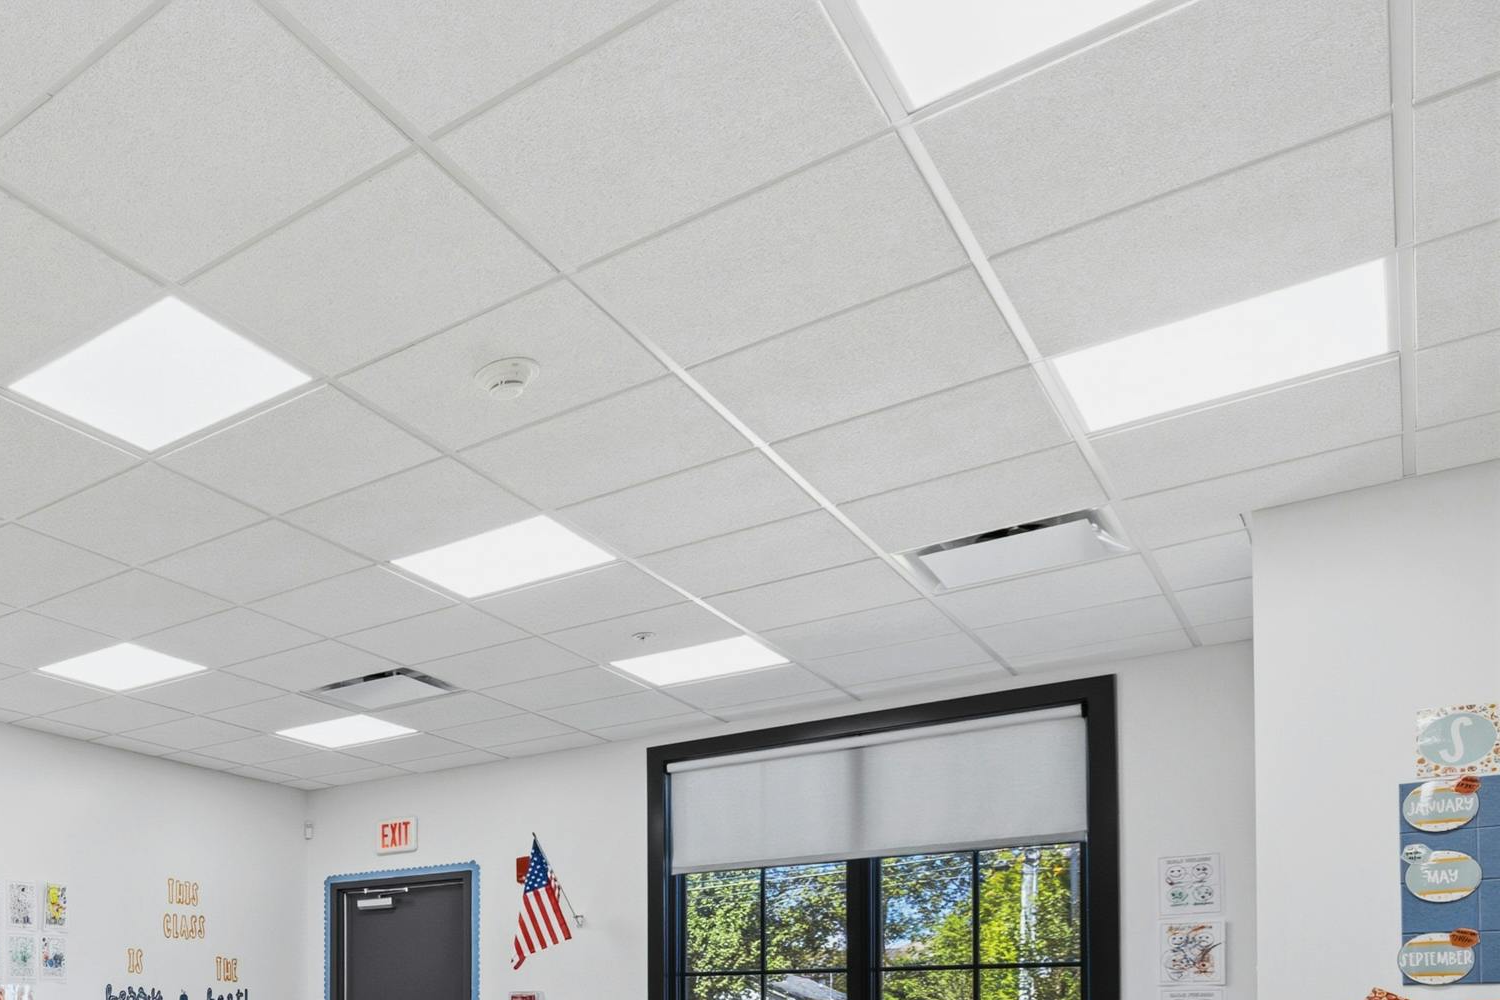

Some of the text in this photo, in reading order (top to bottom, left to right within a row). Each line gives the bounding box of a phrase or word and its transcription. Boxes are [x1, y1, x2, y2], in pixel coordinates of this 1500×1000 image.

[1406, 797, 1475, 816] JANUARY
[381, 821, 411, 848] EXIT
[1426, 868, 1460, 885] MAY
[167, 878, 200, 906] THIS
[162, 913, 206, 940] CLASS
[127, 948, 144, 974] IS
[215, 956, 239, 983] THE
[1399, 950, 1474, 968] SEPTEMBER
